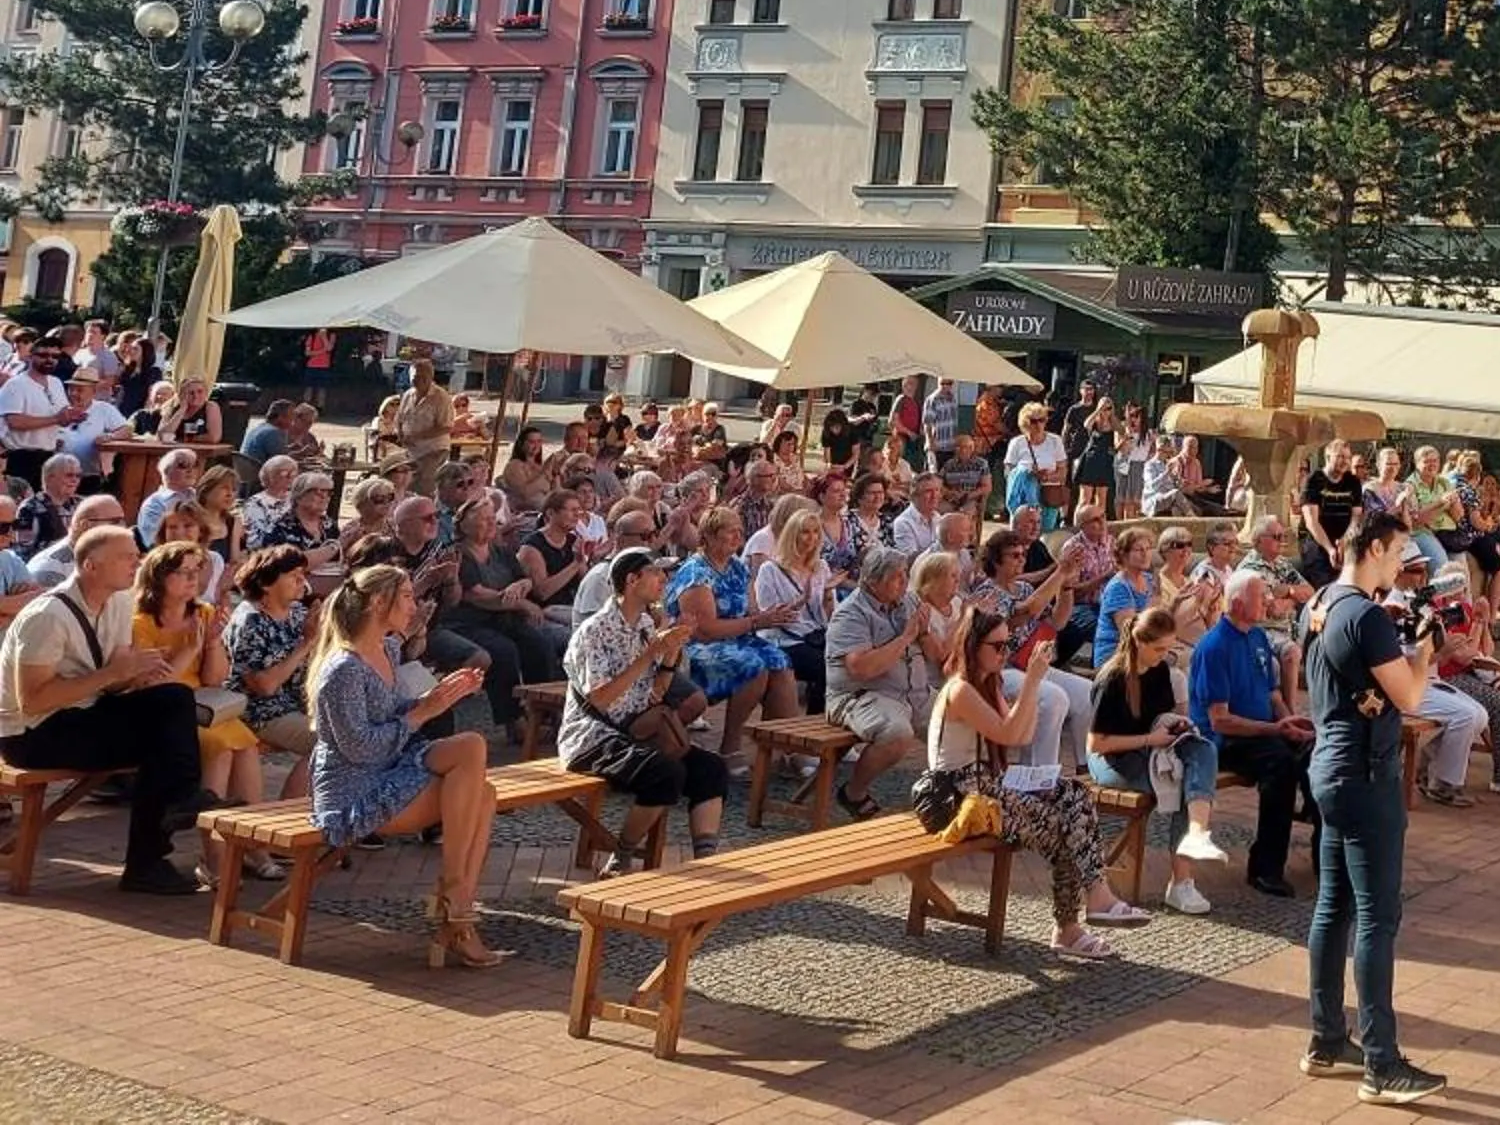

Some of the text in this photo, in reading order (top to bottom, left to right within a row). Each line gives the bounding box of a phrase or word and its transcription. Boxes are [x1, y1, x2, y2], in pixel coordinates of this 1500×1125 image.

[975, 296, 985, 308] U
[1128, 276, 1255, 306] U RŮŽOVÉ ZAHRADY
[952, 310, 1046, 335] ZAHRADY
